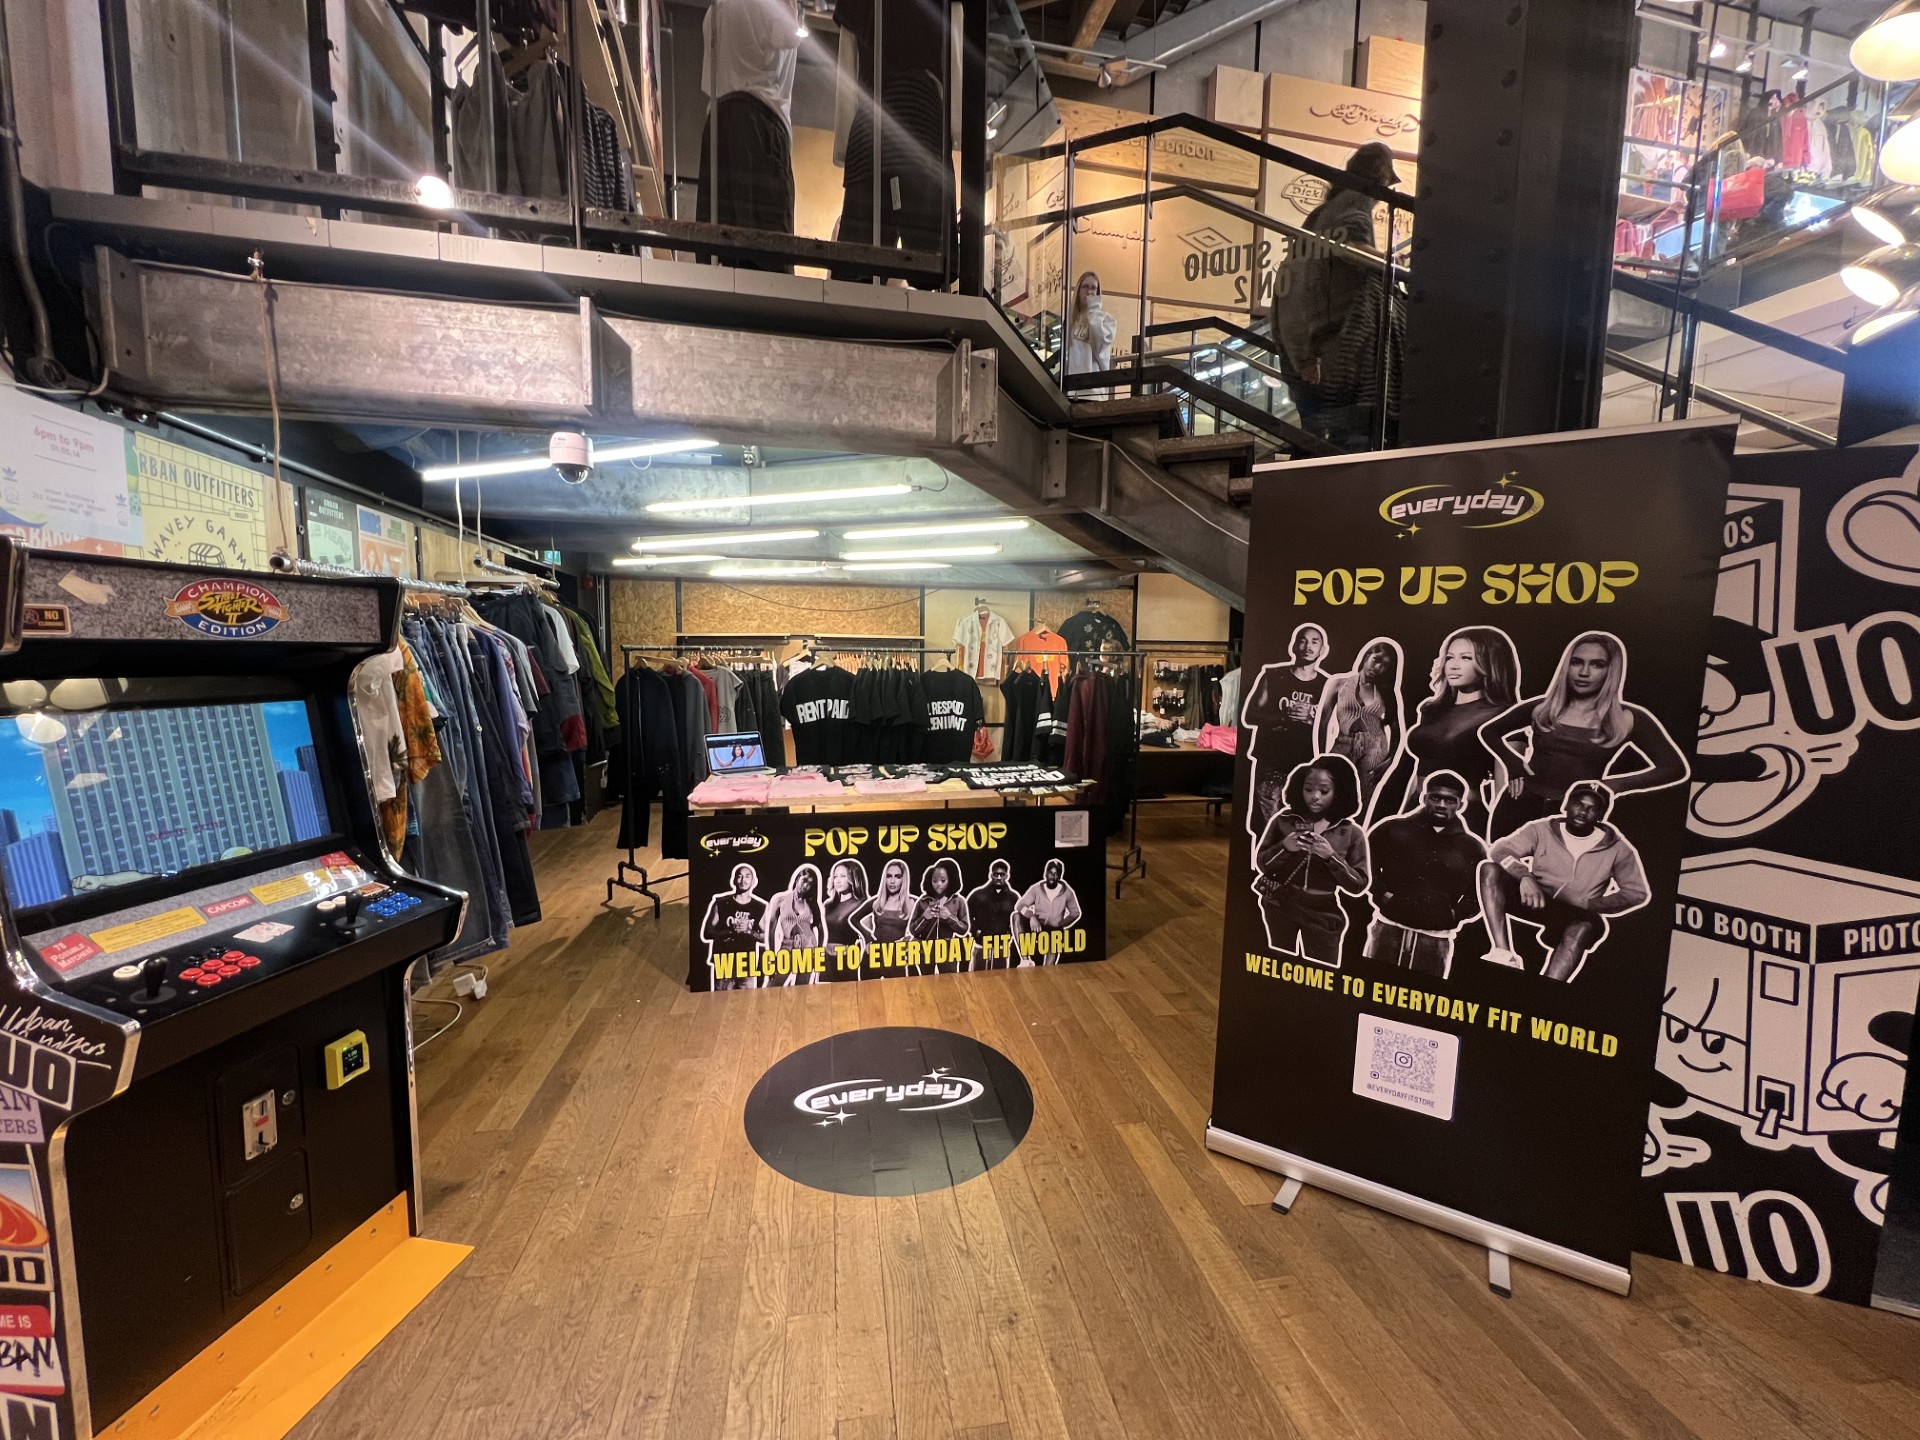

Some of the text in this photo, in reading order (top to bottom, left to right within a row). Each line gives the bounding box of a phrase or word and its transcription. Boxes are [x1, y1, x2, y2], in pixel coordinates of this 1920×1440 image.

[1292, 186, 1324, 199] Dicki
[184, 468, 254, 508] OUTFITTERS
[1391, 488, 1525, 518] everyday
[148, 515, 251, 571] WAVEY GARM
[187, 582, 269, 603] CHAMPION
[1293, 560, 1639, 606] POP UP SHOP
[44, 610, 59, 620] NO
[198, 620, 267, 636] EDITION
[1774, 620, 1920, 736] UO
[1291, 691, 1313, 703] OUT
[706, 834, 762, 848] everyday
[804, 822, 1007, 857] POP UP SHOP
[206, 898, 250, 915] CAPCOM
[1714, 912, 1801, 954] BOOTH
[713, 928, 1087, 980] WELCOME TO EVERYDAY FIT WORLD
[1245, 953, 1619, 1058] WELCOME TO EVERYDAY FIT WORLD
[811, 1080, 962, 1110] everyday
[19, 1315, 32, 1329] IS
